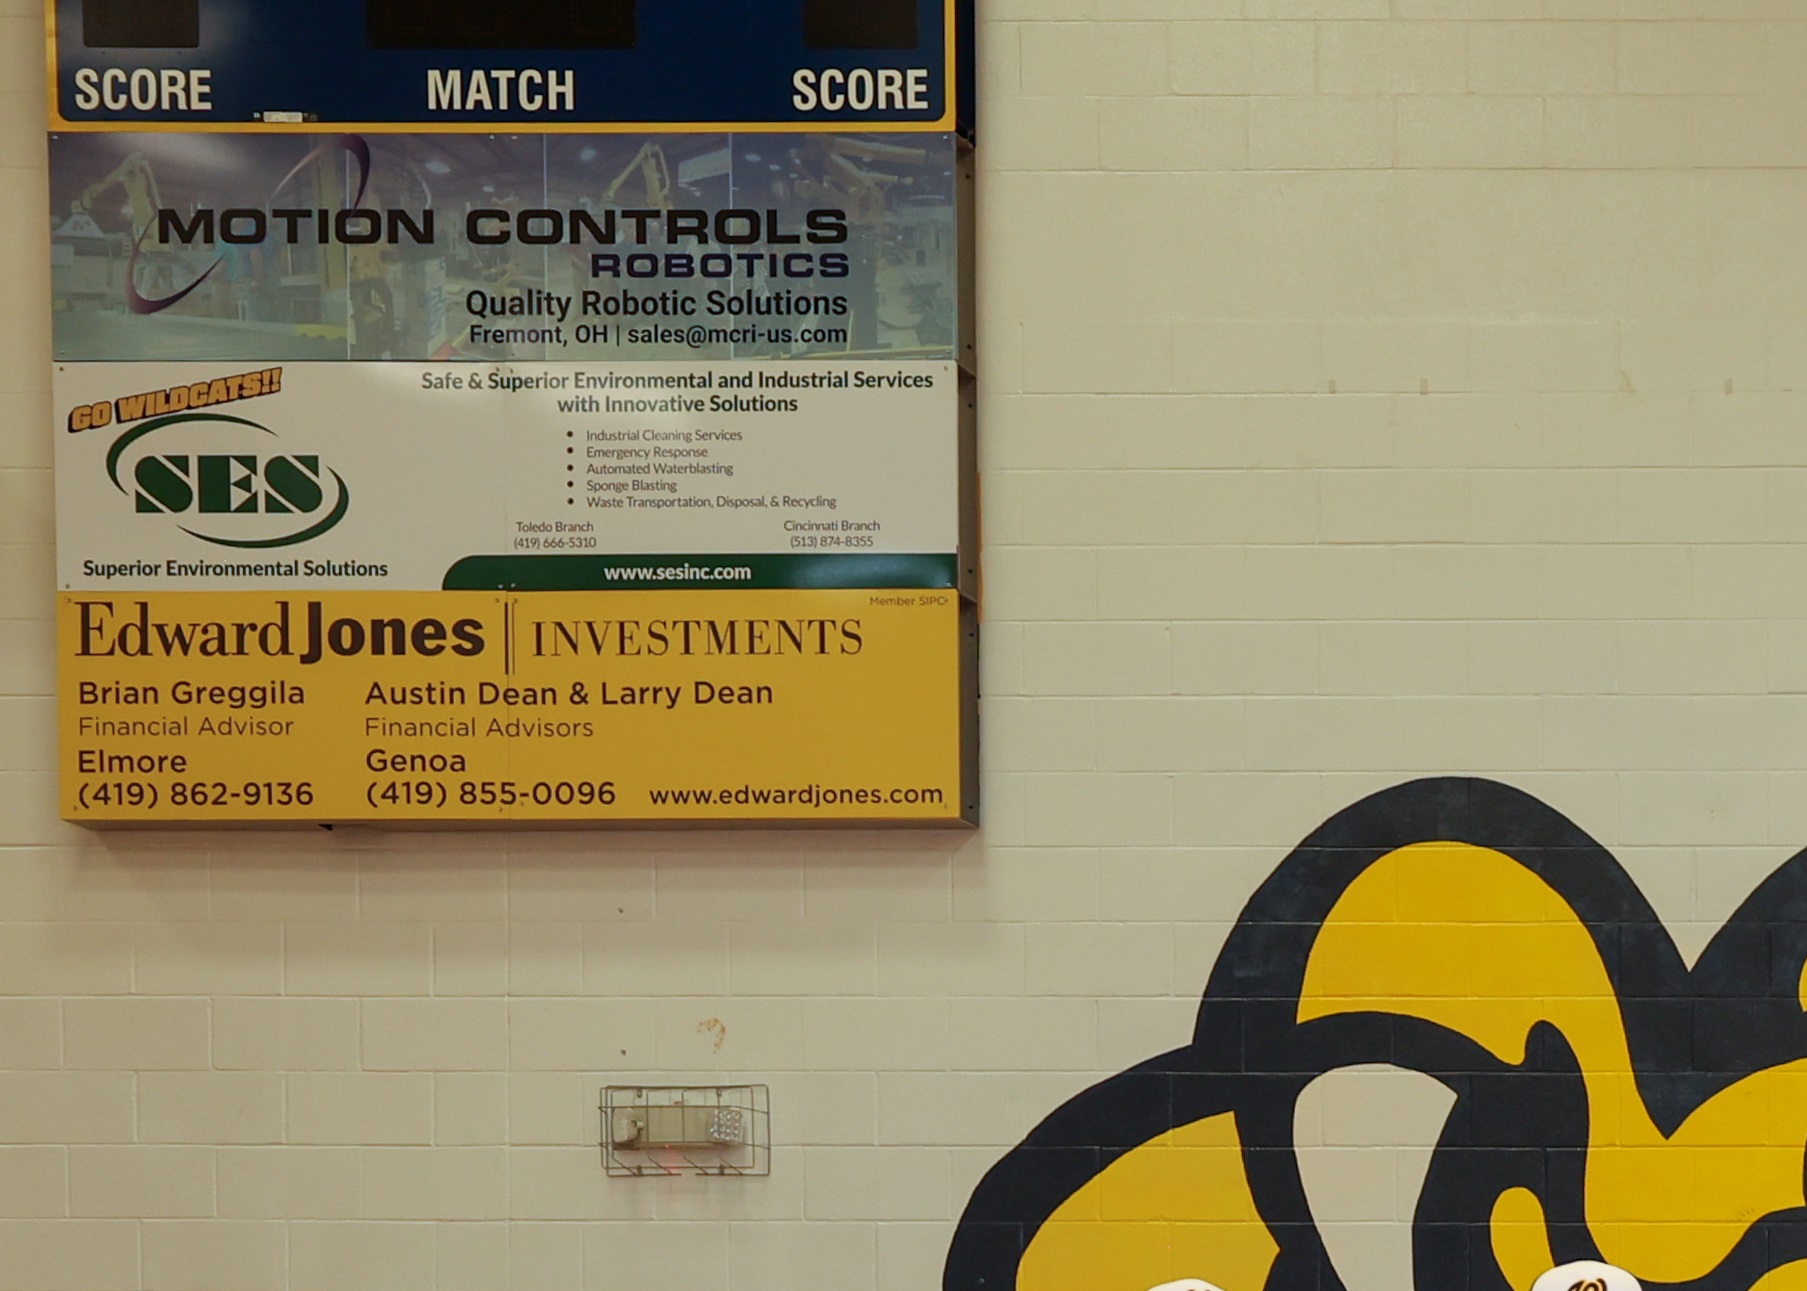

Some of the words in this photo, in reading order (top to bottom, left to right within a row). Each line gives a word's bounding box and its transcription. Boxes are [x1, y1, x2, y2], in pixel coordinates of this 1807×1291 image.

[74, 68, 212, 110] SCORE
[427, 69, 576, 111] MATCH
[791, 69, 929, 111] SCORE
[158, 208, 434, 245] MOTION
[466, 208, 848, 245] CONTROLS
[591, 253, 849, 278] ROBOTICS
[466, 289, 572, 322] Quality
[582, 289, 696, 316] Robotic
[706, 289, 847, 316] Solutions
[470, 325, 567, 347] Fremont,
[575, 325, 608, 344] OH
[627, 325, 847, 348] sales@mcri-us.com
[422, 372, 463, 389] Safe
[468, 373, 482, 389] &
[488, 372, 568, 392] Superior
[575, 370, 712, 389] Environmental
[718, 371, 752, 388] and
[758, 370, 848, 388] Industrial
[854, 371, 933, 388] Services
[68, 401, 112, 433] GO
[115, 367, 282, 424] WILDCATS!!
[557, 395, 599, 412] with
[606, 395, 704, 412] Innovative
[710, 395, 797, 412] Solutions
[587, 430, 639, 441] Industrial
[643, 430, 692, 443] Cleaning
[695, 430, 742, 441] Services
[587, 447, 650, 460] Emergency
[654, 446, 708, 459] Response
[587, 464, 650, 474] Automated
[654, 463, 733, 476] Waterblasting
[135, 455, 323, 513] SES
[587, 480, 628, 492] Sponge
[632, 480, 677, 492] Blasting
[587, 497, 623, 508] Waste
[627, 496, 713, 509] Transportation,
[717, 496, 767, 509] Disposal,
[770, 497, 779, 507] &
[783, 496, 836, 509] Recycling
[516, 522, 552, 533] Toledo
[556, 522, 593, 533] Branch
[784, 520, 838, 531] Cincinnati
[842, 520, 880, 531] Branch
[514, 537, 540, 549] (419)
[543, 537, 596, 548] 666-5310
[790, 536, 817, 548] (513)
[820, 536, 873, 547] 874-8355
[83, 560, 161, 580] Superior
[167, 560, 299, 577] Environmental
[303, 560, 388, 577] Solutions
[604, 563, 751, 580] www.sesinc.com
[869, 596, 916, 606] Member
[533, 619, 864, 658] INVESTMENTS
[79, 680, 160, 706] Brian
[171, 679, 306, 713] Greggila
[365, 680, 467, 707] Austin
[477, 681, 561, 707] Dean
[569, 681, 591, 707] &
[601, 681, 683, 714] Larry
[693, 681, 774, 707] Dean
[78, 716, 190, 738] Financial
[197, 716, 294, 738] Advisor
[365, 717, 478, 739] Financial
[485, 717, 594, 739] Advisors
[78, 749, 188, 774] Elmore
[365, 749, 467, 774] Genoa
[78, 781, 160, 809] (419)
[169, 782, 315, 807] 862-9136
[365, 781, 448, 809] (419)
[458, 781, 618, 807] 855-0096
[650, 782, 944, 809] www.edwardjones.com
